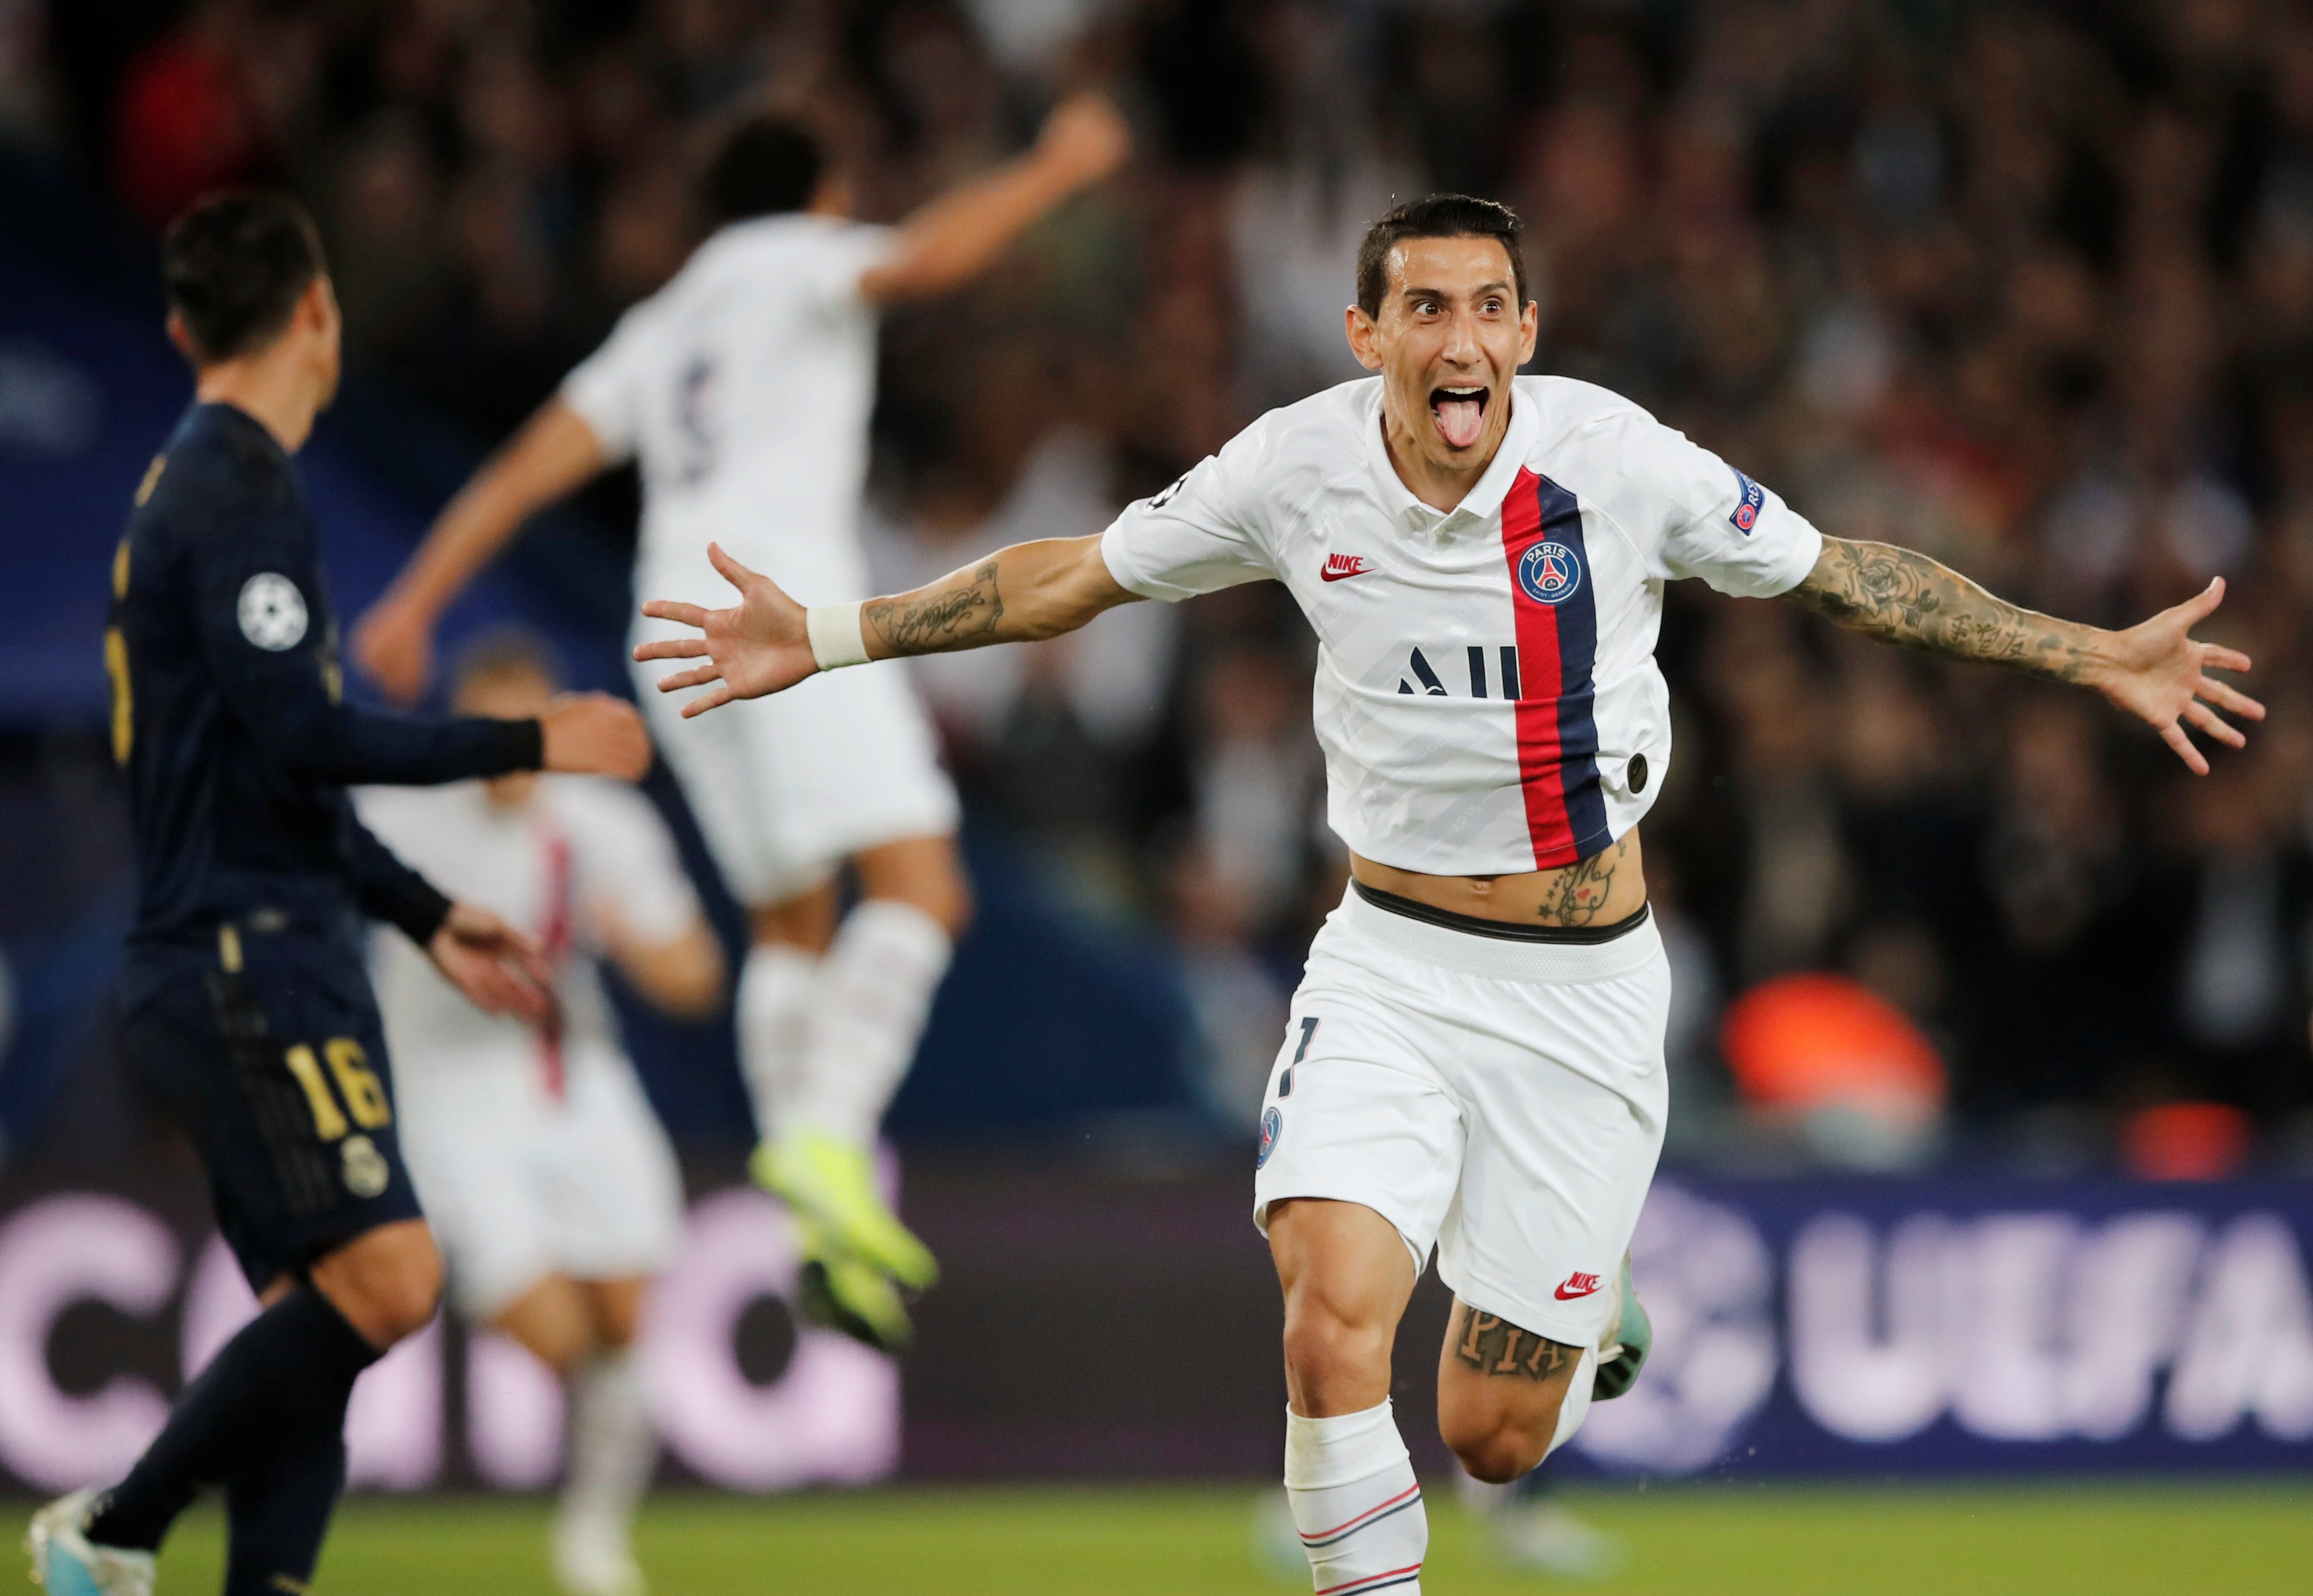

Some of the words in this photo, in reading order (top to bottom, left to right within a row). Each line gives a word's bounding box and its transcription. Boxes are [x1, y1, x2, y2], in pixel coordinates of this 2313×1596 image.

[1329, 553, 1364, 573] NIKE
[1526, 545, 1566, 563] PARIS
[284, 1037, 392, 1141] 16
[1567, 1271, 1600, 1291] NIKE
[1462, 1310, 1564, 1374] PIA
